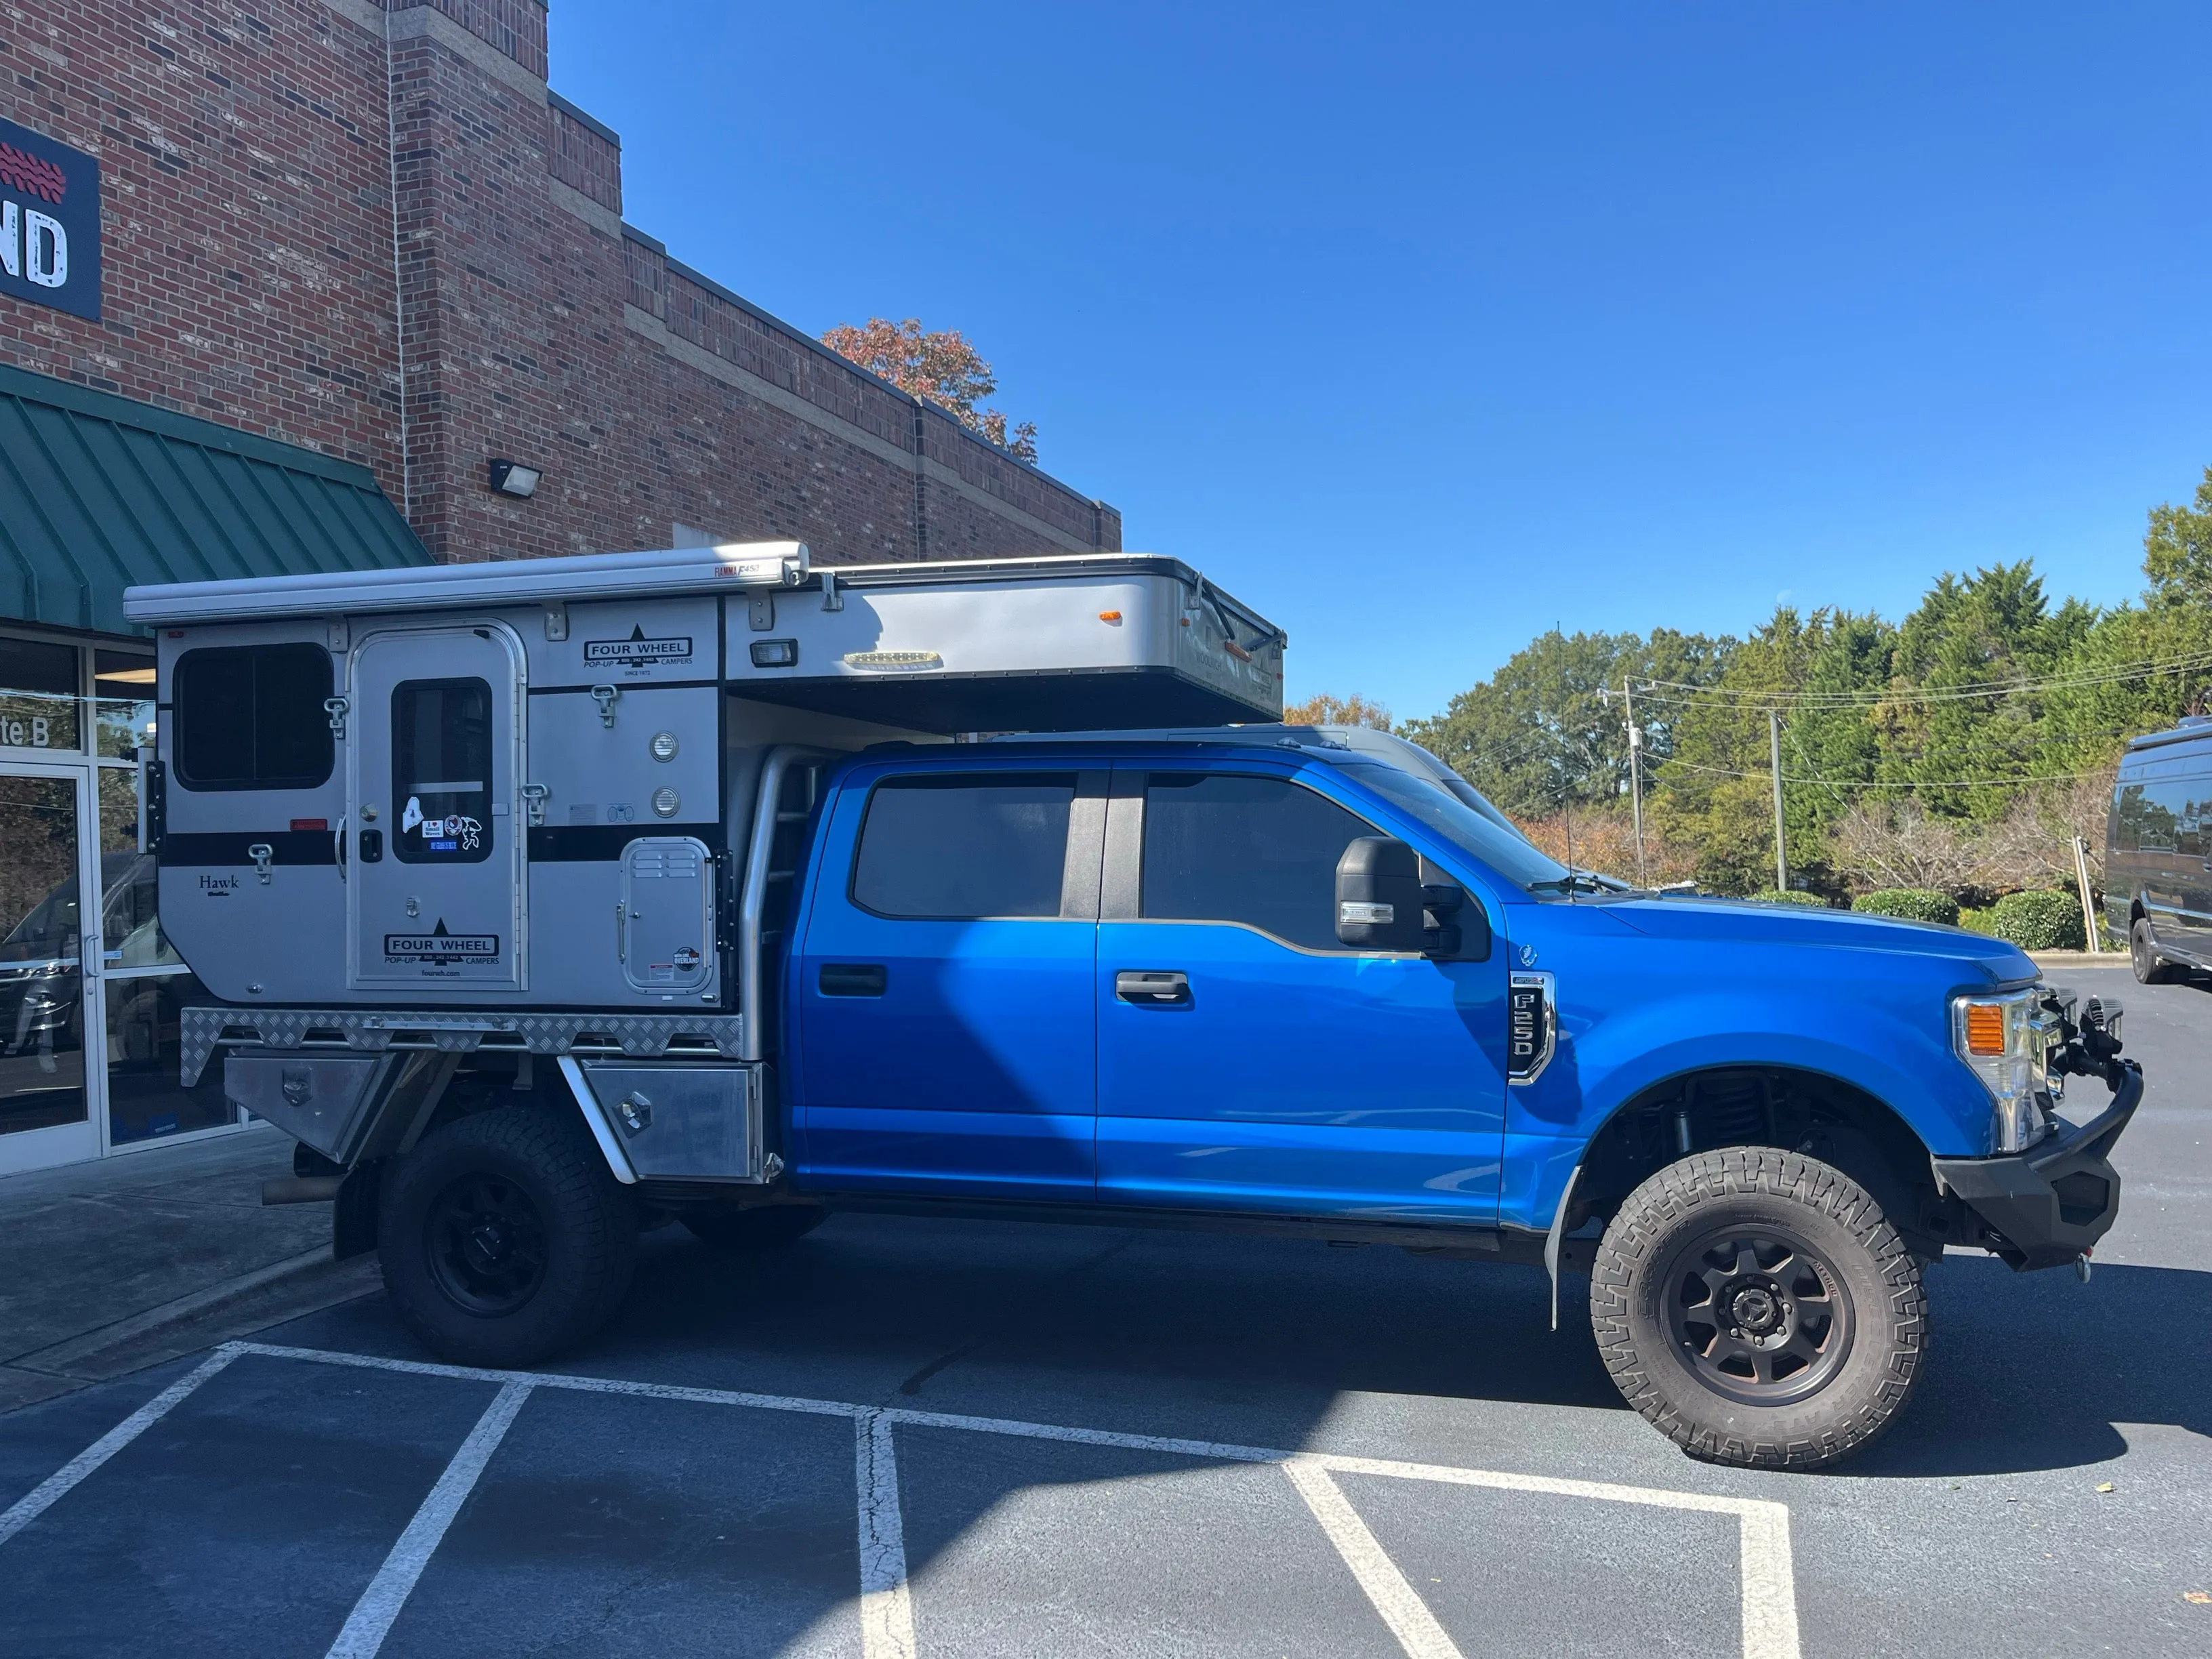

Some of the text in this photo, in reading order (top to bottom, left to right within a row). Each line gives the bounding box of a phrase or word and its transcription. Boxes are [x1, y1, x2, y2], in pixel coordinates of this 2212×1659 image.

[715, 566, 737, 577] FIAMMA
[592, 642, 684, 655] FOUR WHEEL
[33, 717, 49, 745] B
[199, 874, 239, 888] Hawk
[392, 941, 491, 951] FOUR WHEEL
